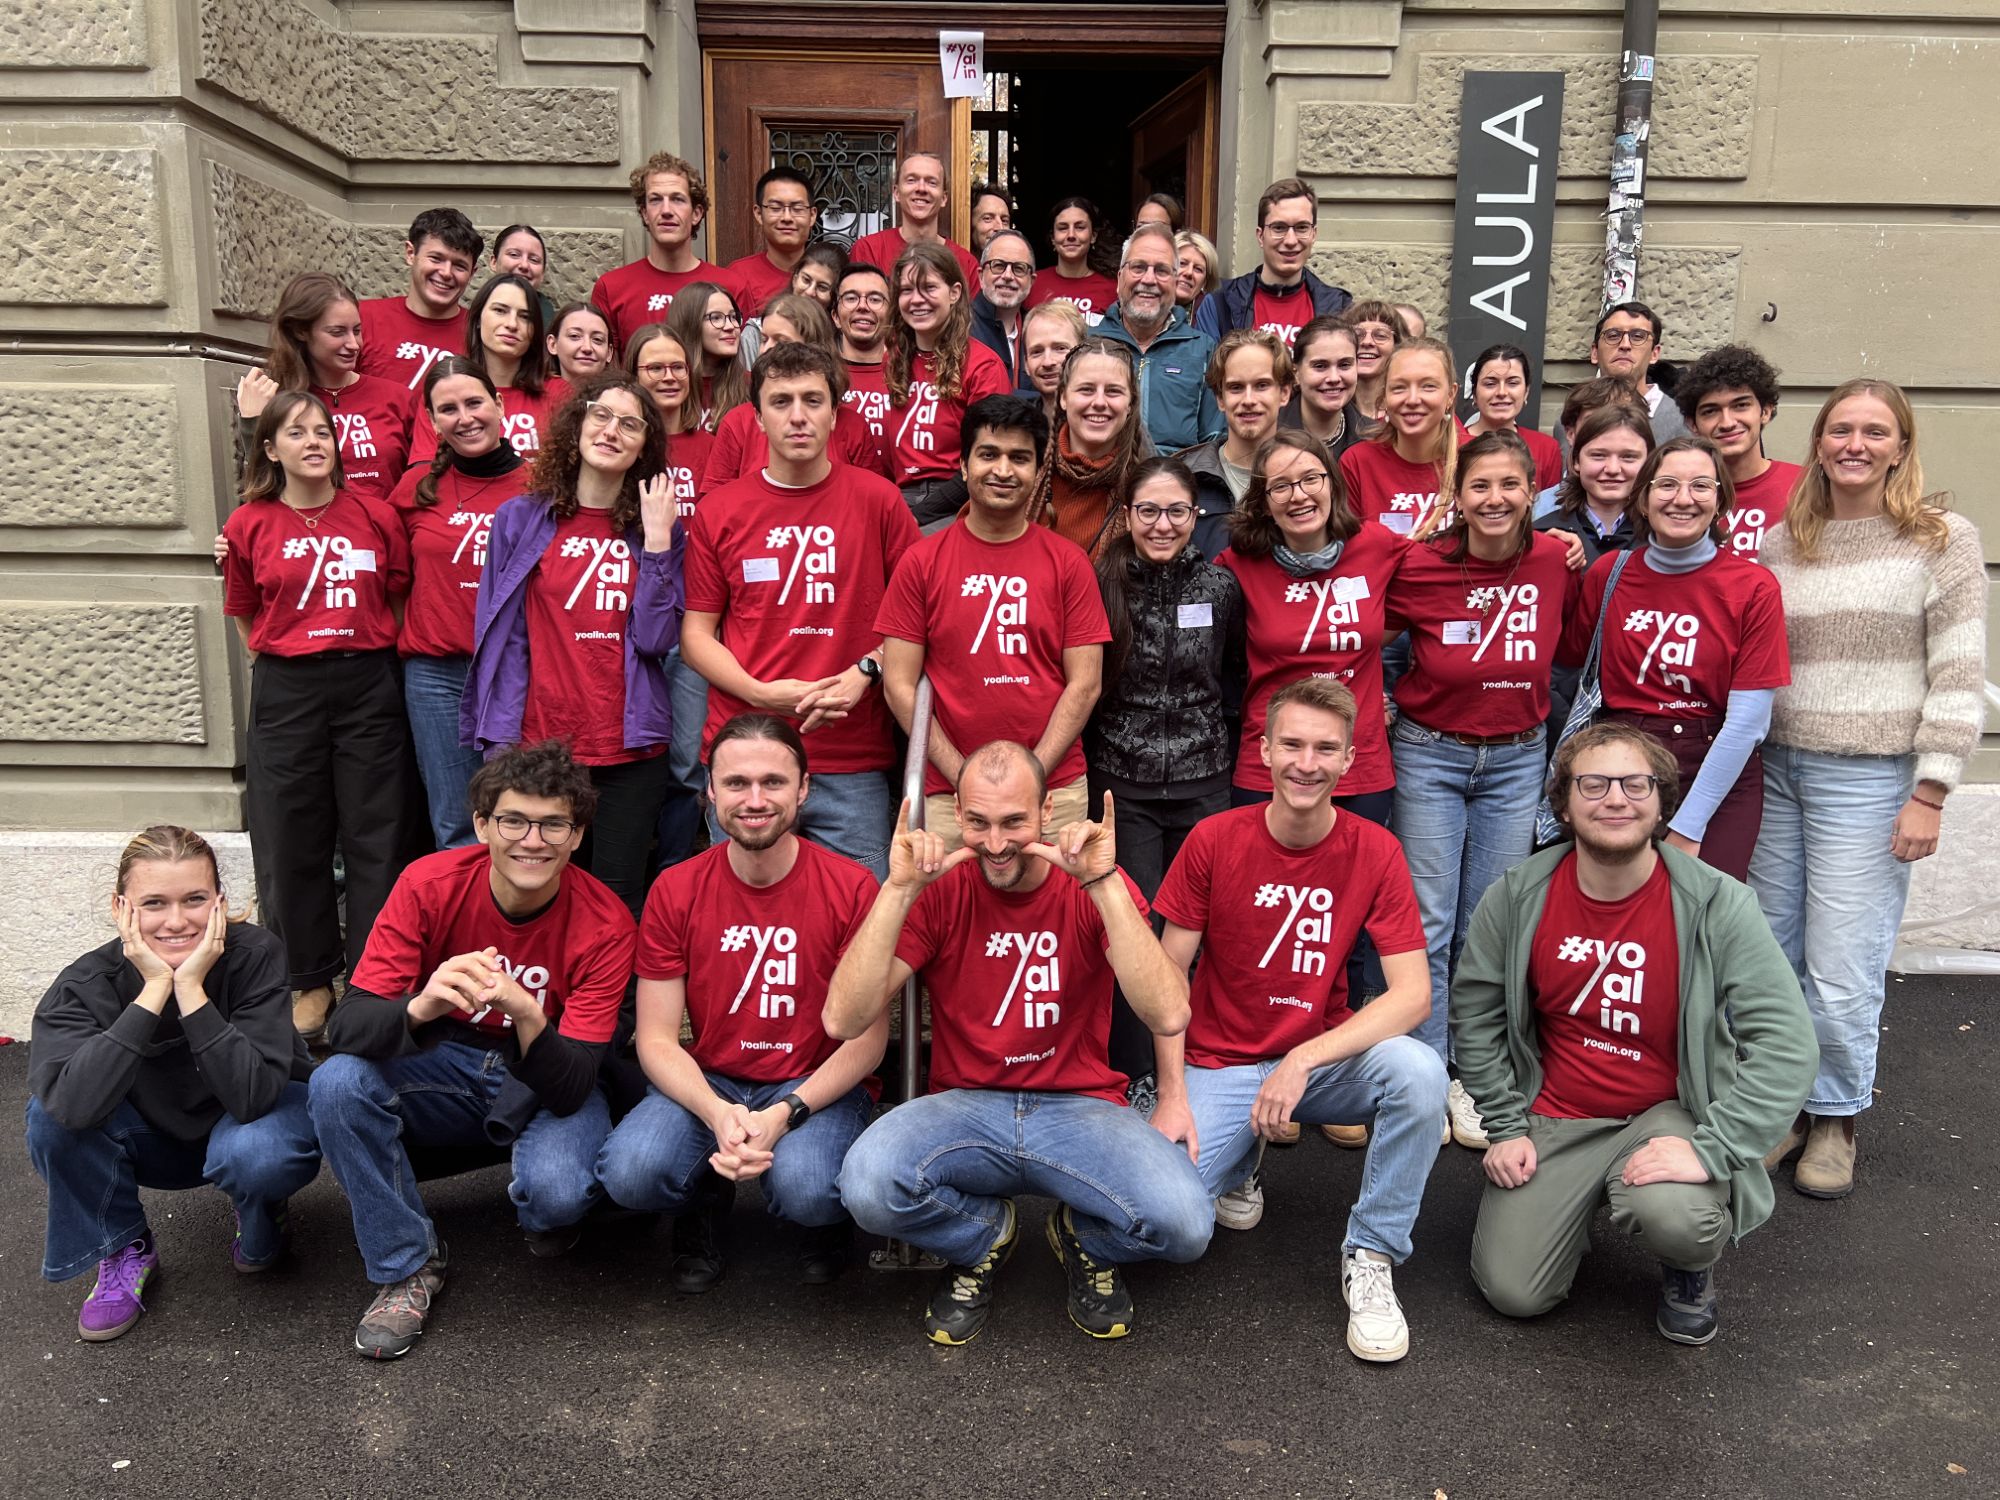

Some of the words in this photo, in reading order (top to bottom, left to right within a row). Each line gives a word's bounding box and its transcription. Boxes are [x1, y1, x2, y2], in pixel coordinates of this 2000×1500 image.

[963, 53, 976, 65] al
[963, 66, 977, 79] in
[1469, 95, 1544, 331] AULA
[864, 403, 884, 418] al
[916, 401, 938, 424] al
[350, 426, 373, 442] al
[501, 413, 535, 439] yo
[511, 427, 540, 451] al
[913, 424, 934, 451] in
[352, 441, 377, 458] in
[666, 467, 692, 482] yo
[675, 480, 695, 498] al
[675, 497, 696, 516] in
[1732, 526, 1765, 551] al
[597, 560, 630, 584] al
[805, 546, 836, 574] al
[325, 581, 357, 609] in
[595, 582, 627, 612] in
[805, 575, 835, 604] in
[996, 597, 1027, 626] al
[1506, 604, 1538, 633] al
[307, 628, 354, 639] yoalin.org
[575, 631, 620, 641] yoalin.org
[789, 626, 834, 637] yoalin.org
[997, 625, 1028, 655] in
[1328, 625, 1362, 652] in
[1504, 632, 1537, 662] in
[1660, 638, 1697, 667] al
[984, 675, 1030, 686] yoalin.org
[1482, 680, 1532, 690] yoalin.org
[1658, 663, 1691, 694] in
[1295, 912, 1333, 944] al
[763, 952, 797, 986] al
[1291, 940, 1326, 976] in
[1025, 956, 1060, 992] al
[1602, 970, 1645, 1004] al
[759, 984, 795, 1018] in
[1024, 991, 1060, 1028] in
[1269, 996, 1313, 1012] yoalin.org
[1600, 998, 1641, 1035] in
[740, 1040, 793, 1053] yoalin.org
[1005, 1047, 1056, 1067] yoalin.org
[1583, 1037, 1641, 1062] yoalin.org
